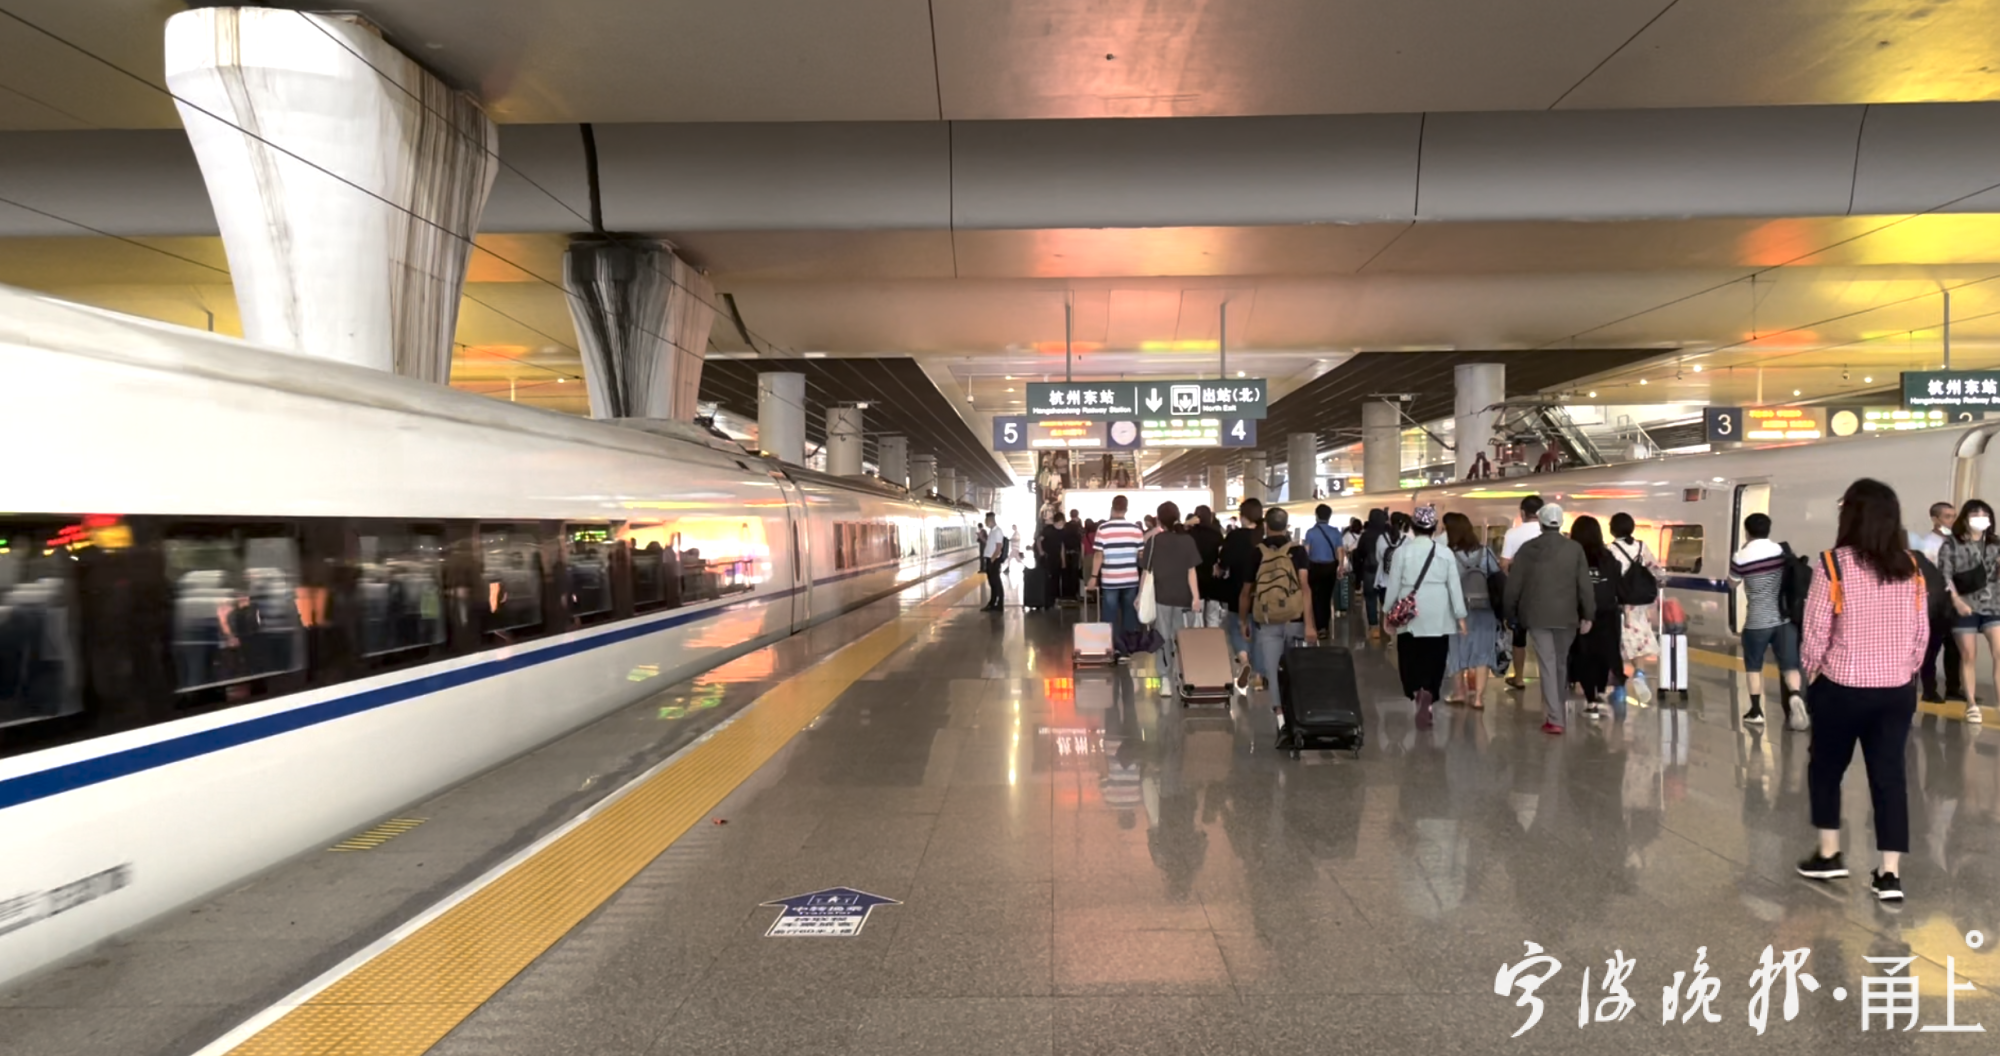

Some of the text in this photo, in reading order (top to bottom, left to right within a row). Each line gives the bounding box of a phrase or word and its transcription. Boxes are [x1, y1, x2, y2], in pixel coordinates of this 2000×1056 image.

[1927, 379, 1998, 395] 杭州东站
[1049, 389, 1115, 406] 杭州东站
[1963, 397, 1990, 405] Railway
[1082, 407, 1108, 415] Railway
[1109, 406, 1132, 414] Station
[1223, 404, 1237, 412] Exit
[1004, 422, 1018, 443] 5
[1231, 419, 1246, 440] 4
[1717, 414, 1732, 435] 3
[1333, 480, 1341, 491] 3
